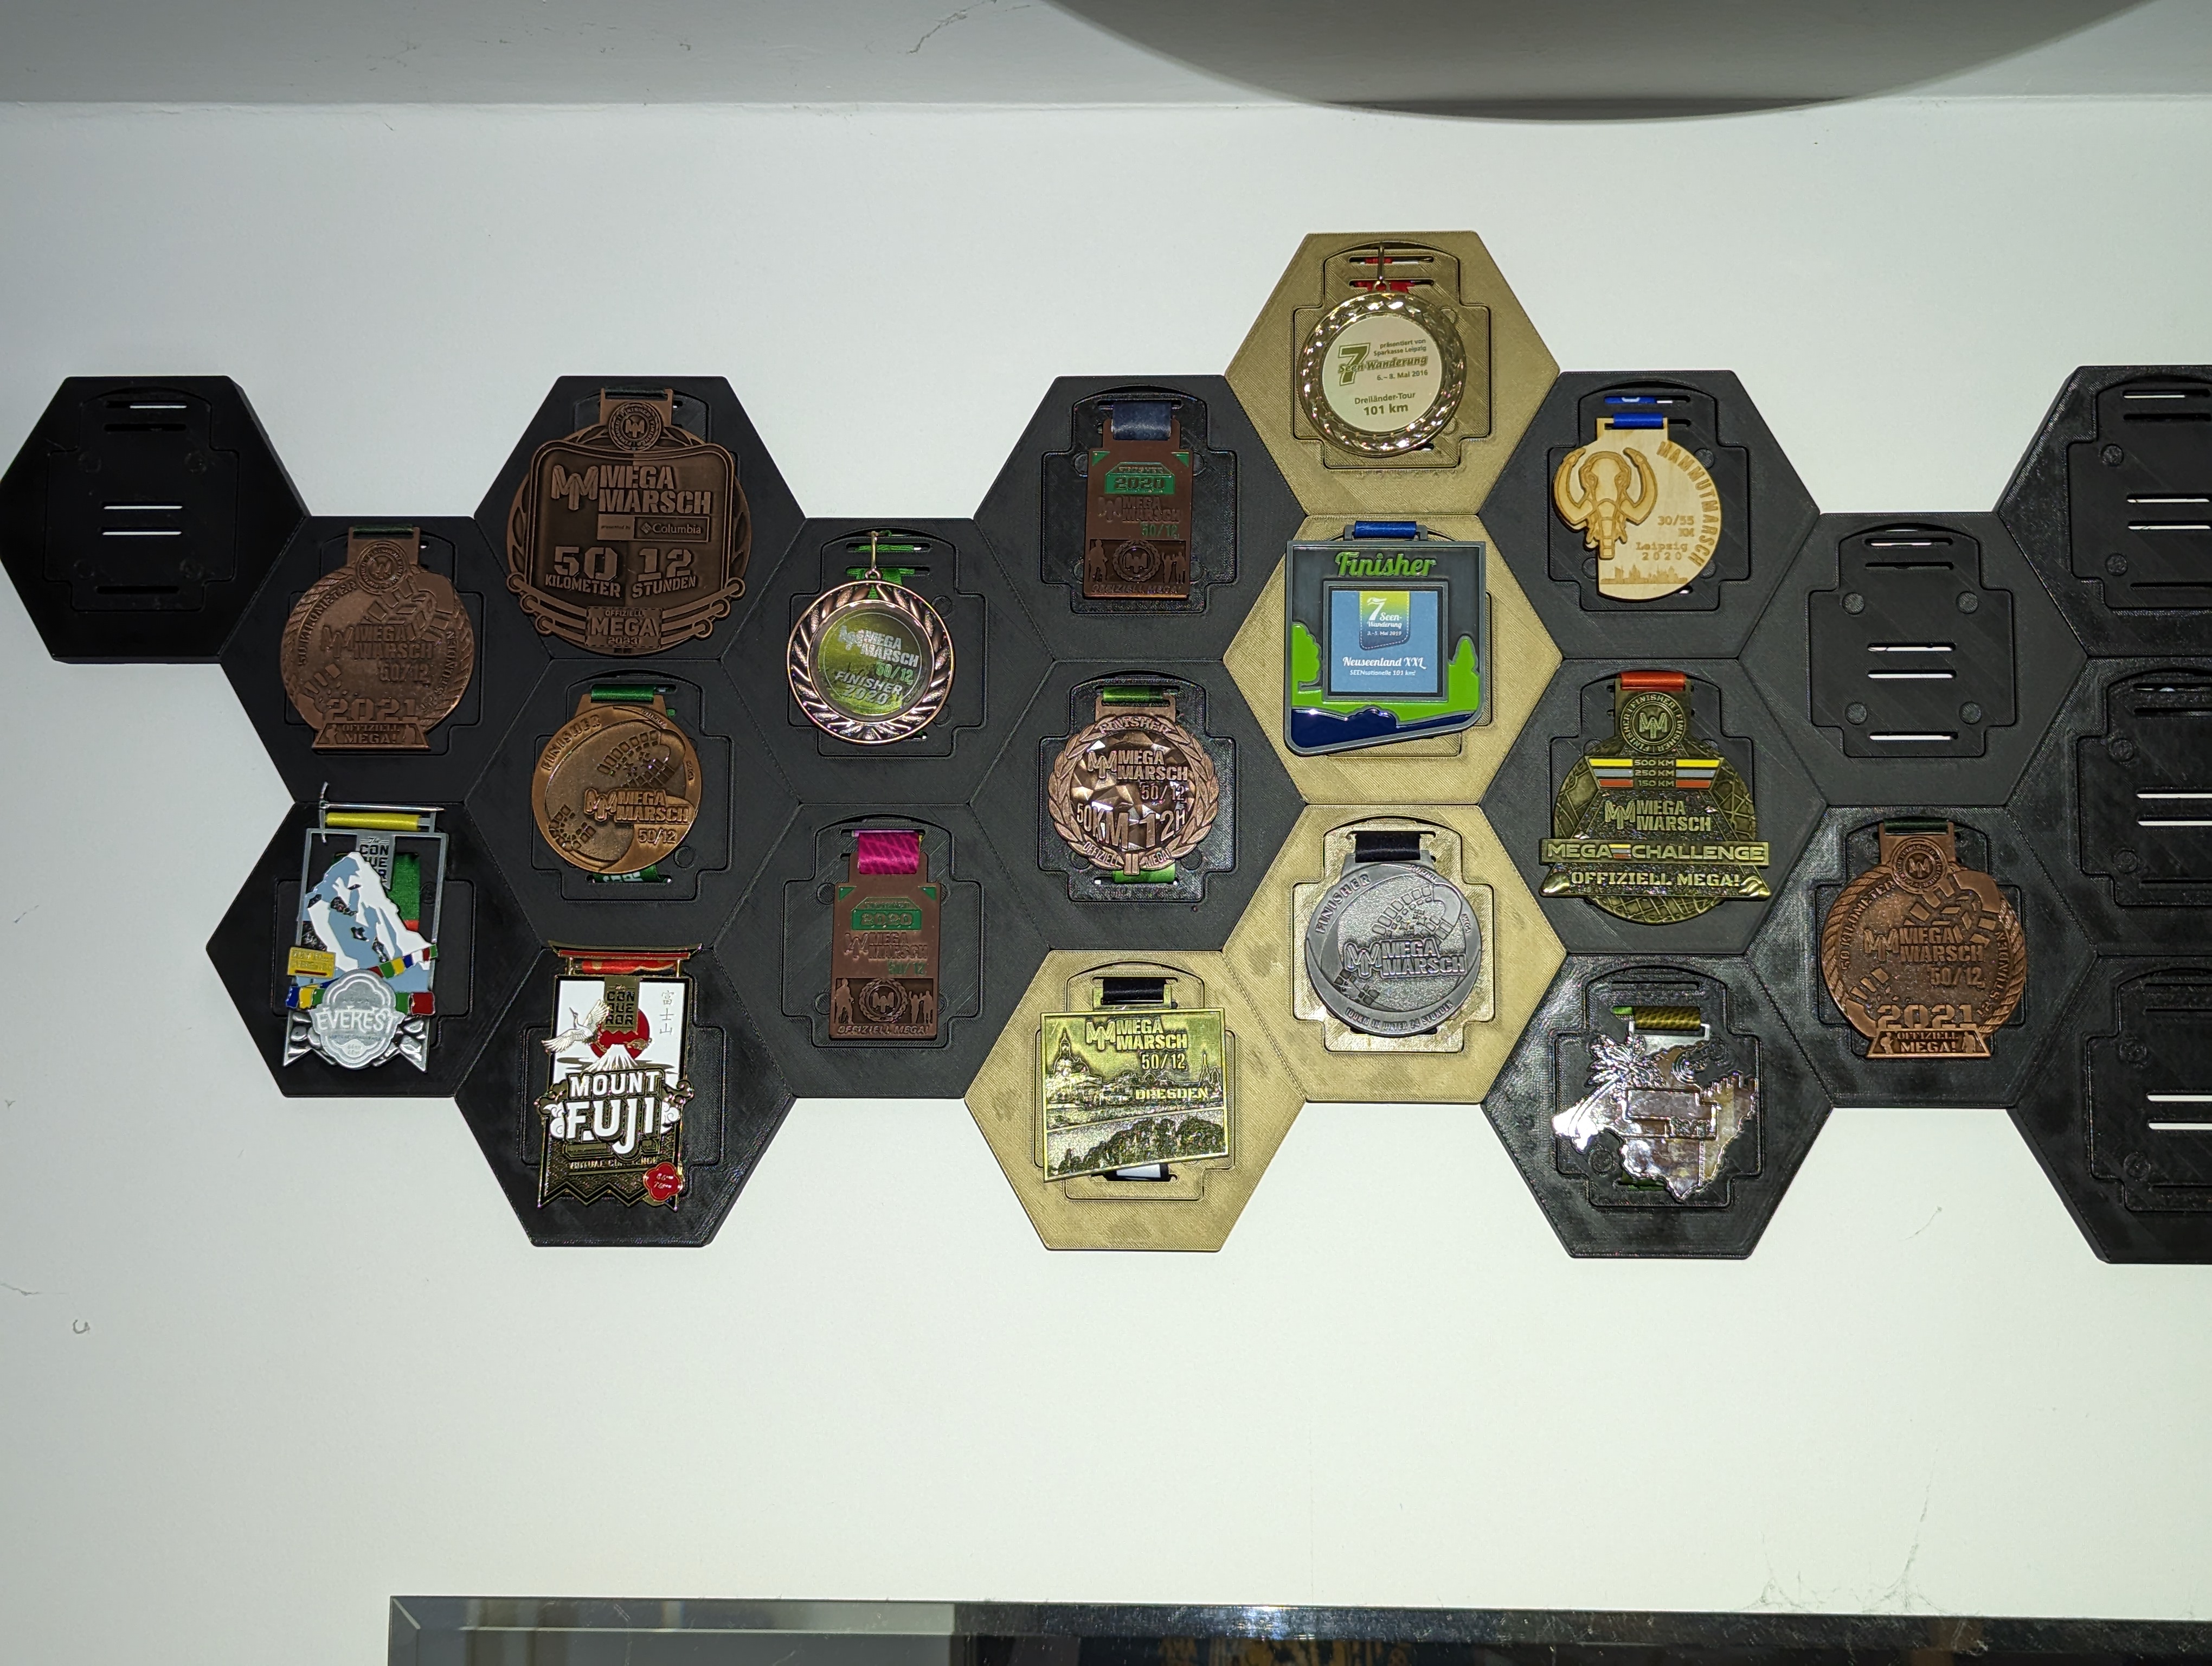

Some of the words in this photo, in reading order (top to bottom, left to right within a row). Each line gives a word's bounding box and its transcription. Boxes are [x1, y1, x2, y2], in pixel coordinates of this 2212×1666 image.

[1380, 339, 1412, 349] präsentiert
[1338, 342, 1371, 386] 7
[1354, 392, 1416, 405] Dreiländer-Tour
[1364, 405, 1384, 415] 101
[1389, 403, 1409, 413] km
[599, 465, 674, 489] MEGA
[599, 489, 711, 514] MARSCH
[1656, 441, 1719, 567] MAMMUTMARSCH
[652, 523, 702, 534] Columbia
[1657, 515, 1695, 526] 30/55
[1636, 542, 1688, 552] Leipzig
[554, 547, 618, 582] 50
[638, 548, 691, 582] 12
[1335, 551, 1437, 577] Finisher
[545, 574, 621, 598] KILOMETER
[632, 575, 697, 598] STUNDEN
[1367, 597, 1387, 620] 7
[1379, 612, 1402, 621] Seen-
[355, 624, 407, 642] MEGA
[1367, 620, 1402, 629] Wanderung
[864, 630, 902, 650] MEGA
[354, 643, 434, 660] MARSCH
[860, 643, 920, 668] MARSCH
[1342, 656, 1402, 667] Neuseenland
[1403, 657, 1426, 670] XXL
[875, 661, 915, 685] 50/12
[835, 670, 903, 696] FINISHER
[843, 684, 890, 704] 2020
[1630, 694, 1676, 708] FINISHER
[327, 698, 417, 721] 2021
[1098, 717, 1172, 734] FINISHER
[344, 733, 397, 744] MEGA!
[541, 715, 602, 771] FINISHER
[1118, 750, 1165, 765] MEGA
[1117, 765, 1188, 781] MARSCH
[617, 790, 667, 806] MEGA
[616, 805, 689, 823] MARSCH
[1636, 800, 1686, 815] MEGA
[1636, 816, 1711, 831] MARSCH
[638, 826, 677, 846] 50/12
[359, 844, 389, 855] CON
[1083, 841, 1121, 867] OFFIZIELL
[1547, 842, 1612, 858] MEGA
[1632, 845, 1765, 861] CHALLENGE
[1571, 871, 1672, 886] OFFIZIELL
[1677, 873, 1740, 887] MEGA!
[1315, 873, 1371, 934] FINISHER
[1841, 880, 1895, 947] KILOMETER
[1900, 927, 1952, 944] MEGA
[1382, 940, 1437, 958] MEGA
[1900, 945, 1984, 963] MARSCH
[1382, 956, 1465, 976] MARSCH
[607, 991, 635, 1002] CON
[316, 1005, 399, 1034] EVEREST
[659, 990, 674, 1035] 富士山
[1422, 1000, 1454, 1024] STUNDEN
[1877, 1003, 1974, 1029] 2021
[1116, 1018, 1163, 1035] MEGA
[1898, 1031, 1958, 1040] OFFIZIELL
[1116, 1035, 1188, 1051] MARSCH
[1901, 1041, 1957, 1053] MEGA!
[570, 1071, 661, 1099] MOUNT
[1135, 1087, 1208, 1100] DRESDEN
[565, 1096, 655, 1155] FUJI
